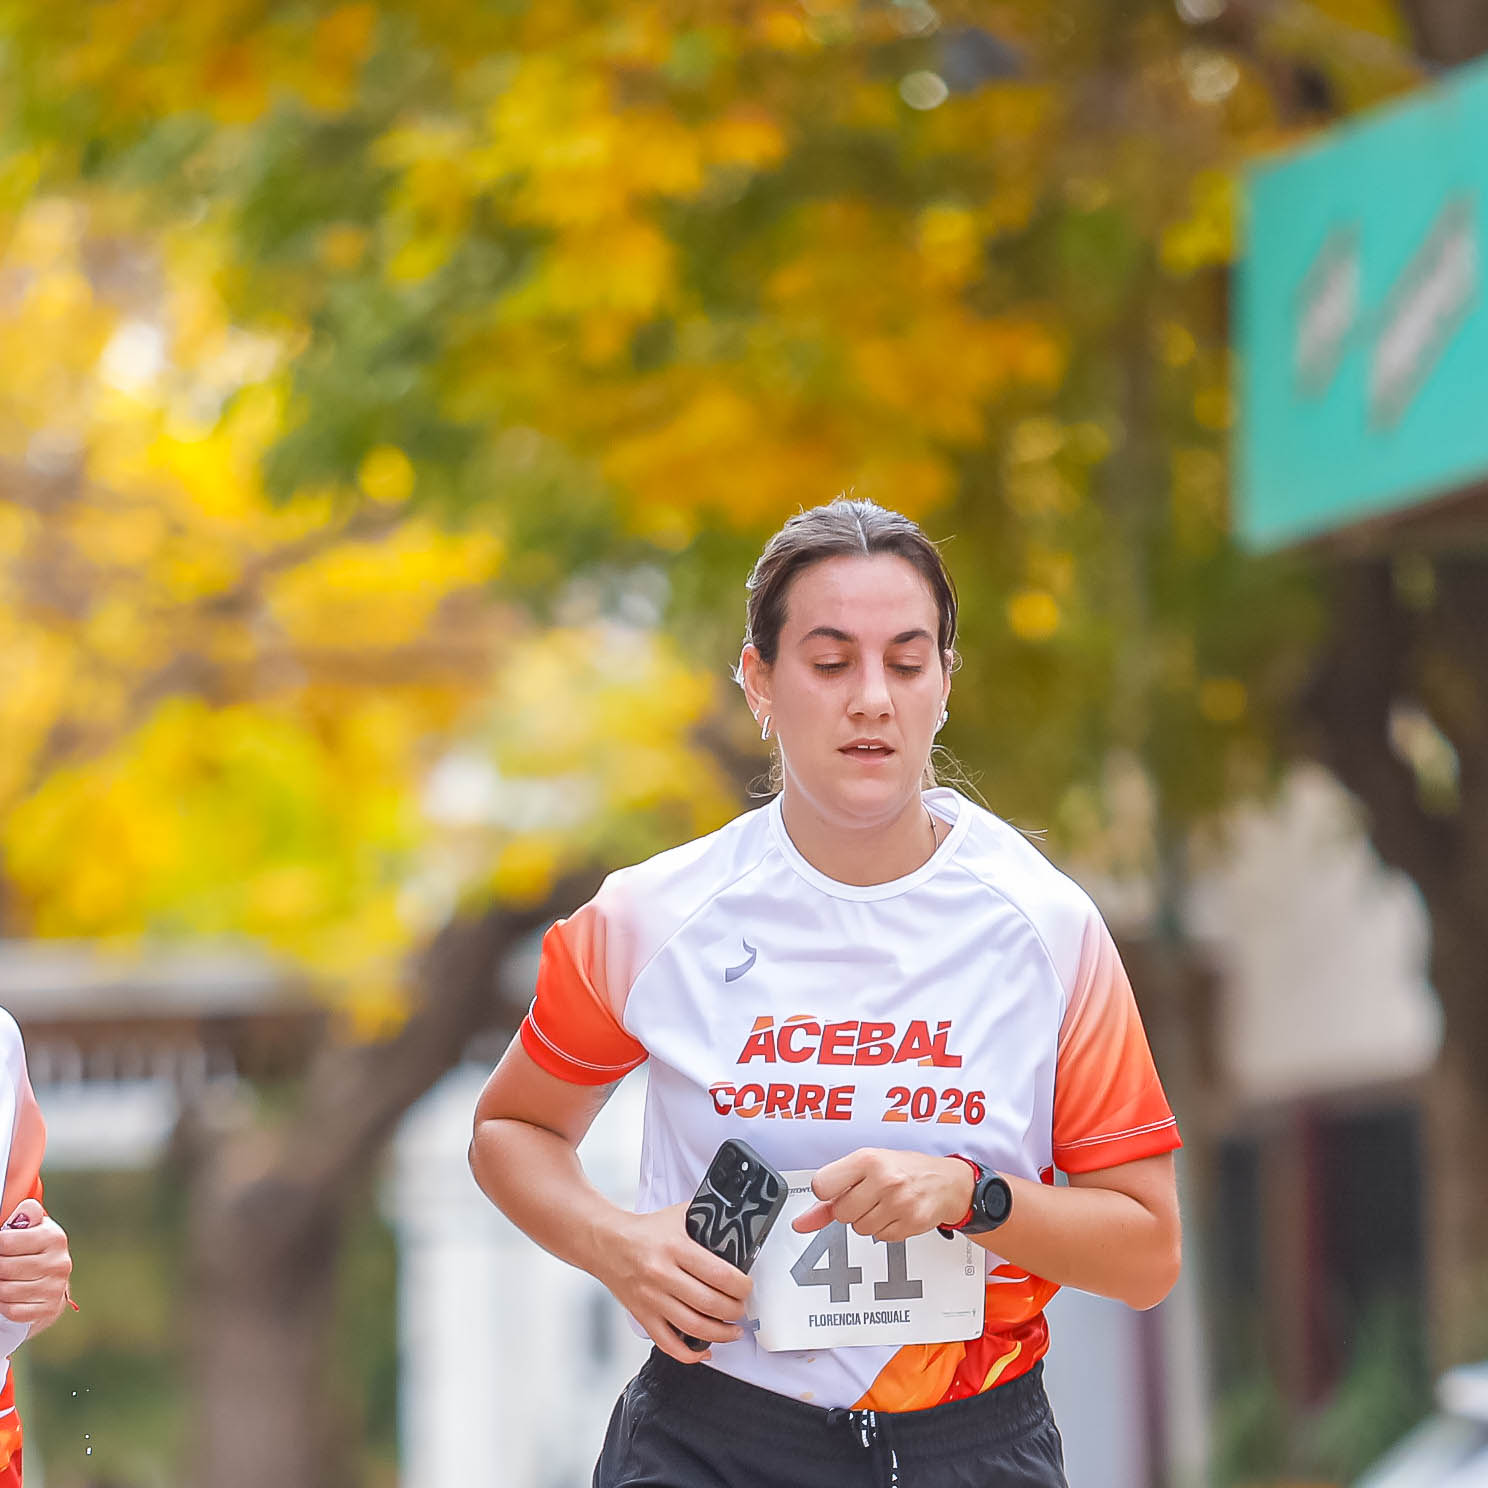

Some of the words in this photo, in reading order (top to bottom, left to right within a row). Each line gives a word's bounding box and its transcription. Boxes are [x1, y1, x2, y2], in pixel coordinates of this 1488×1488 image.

[736, 1014, 962, 1068] ACEBAL
[708, 1082, 856, 1121] CORRE
[882, 1086, 986, 1126] 2026
[790, 1220, 923, 1303] 41
[808, 1312, 862, 1328] FLORENCIA
[863, 1309, 911, 1325] PASQUALE
